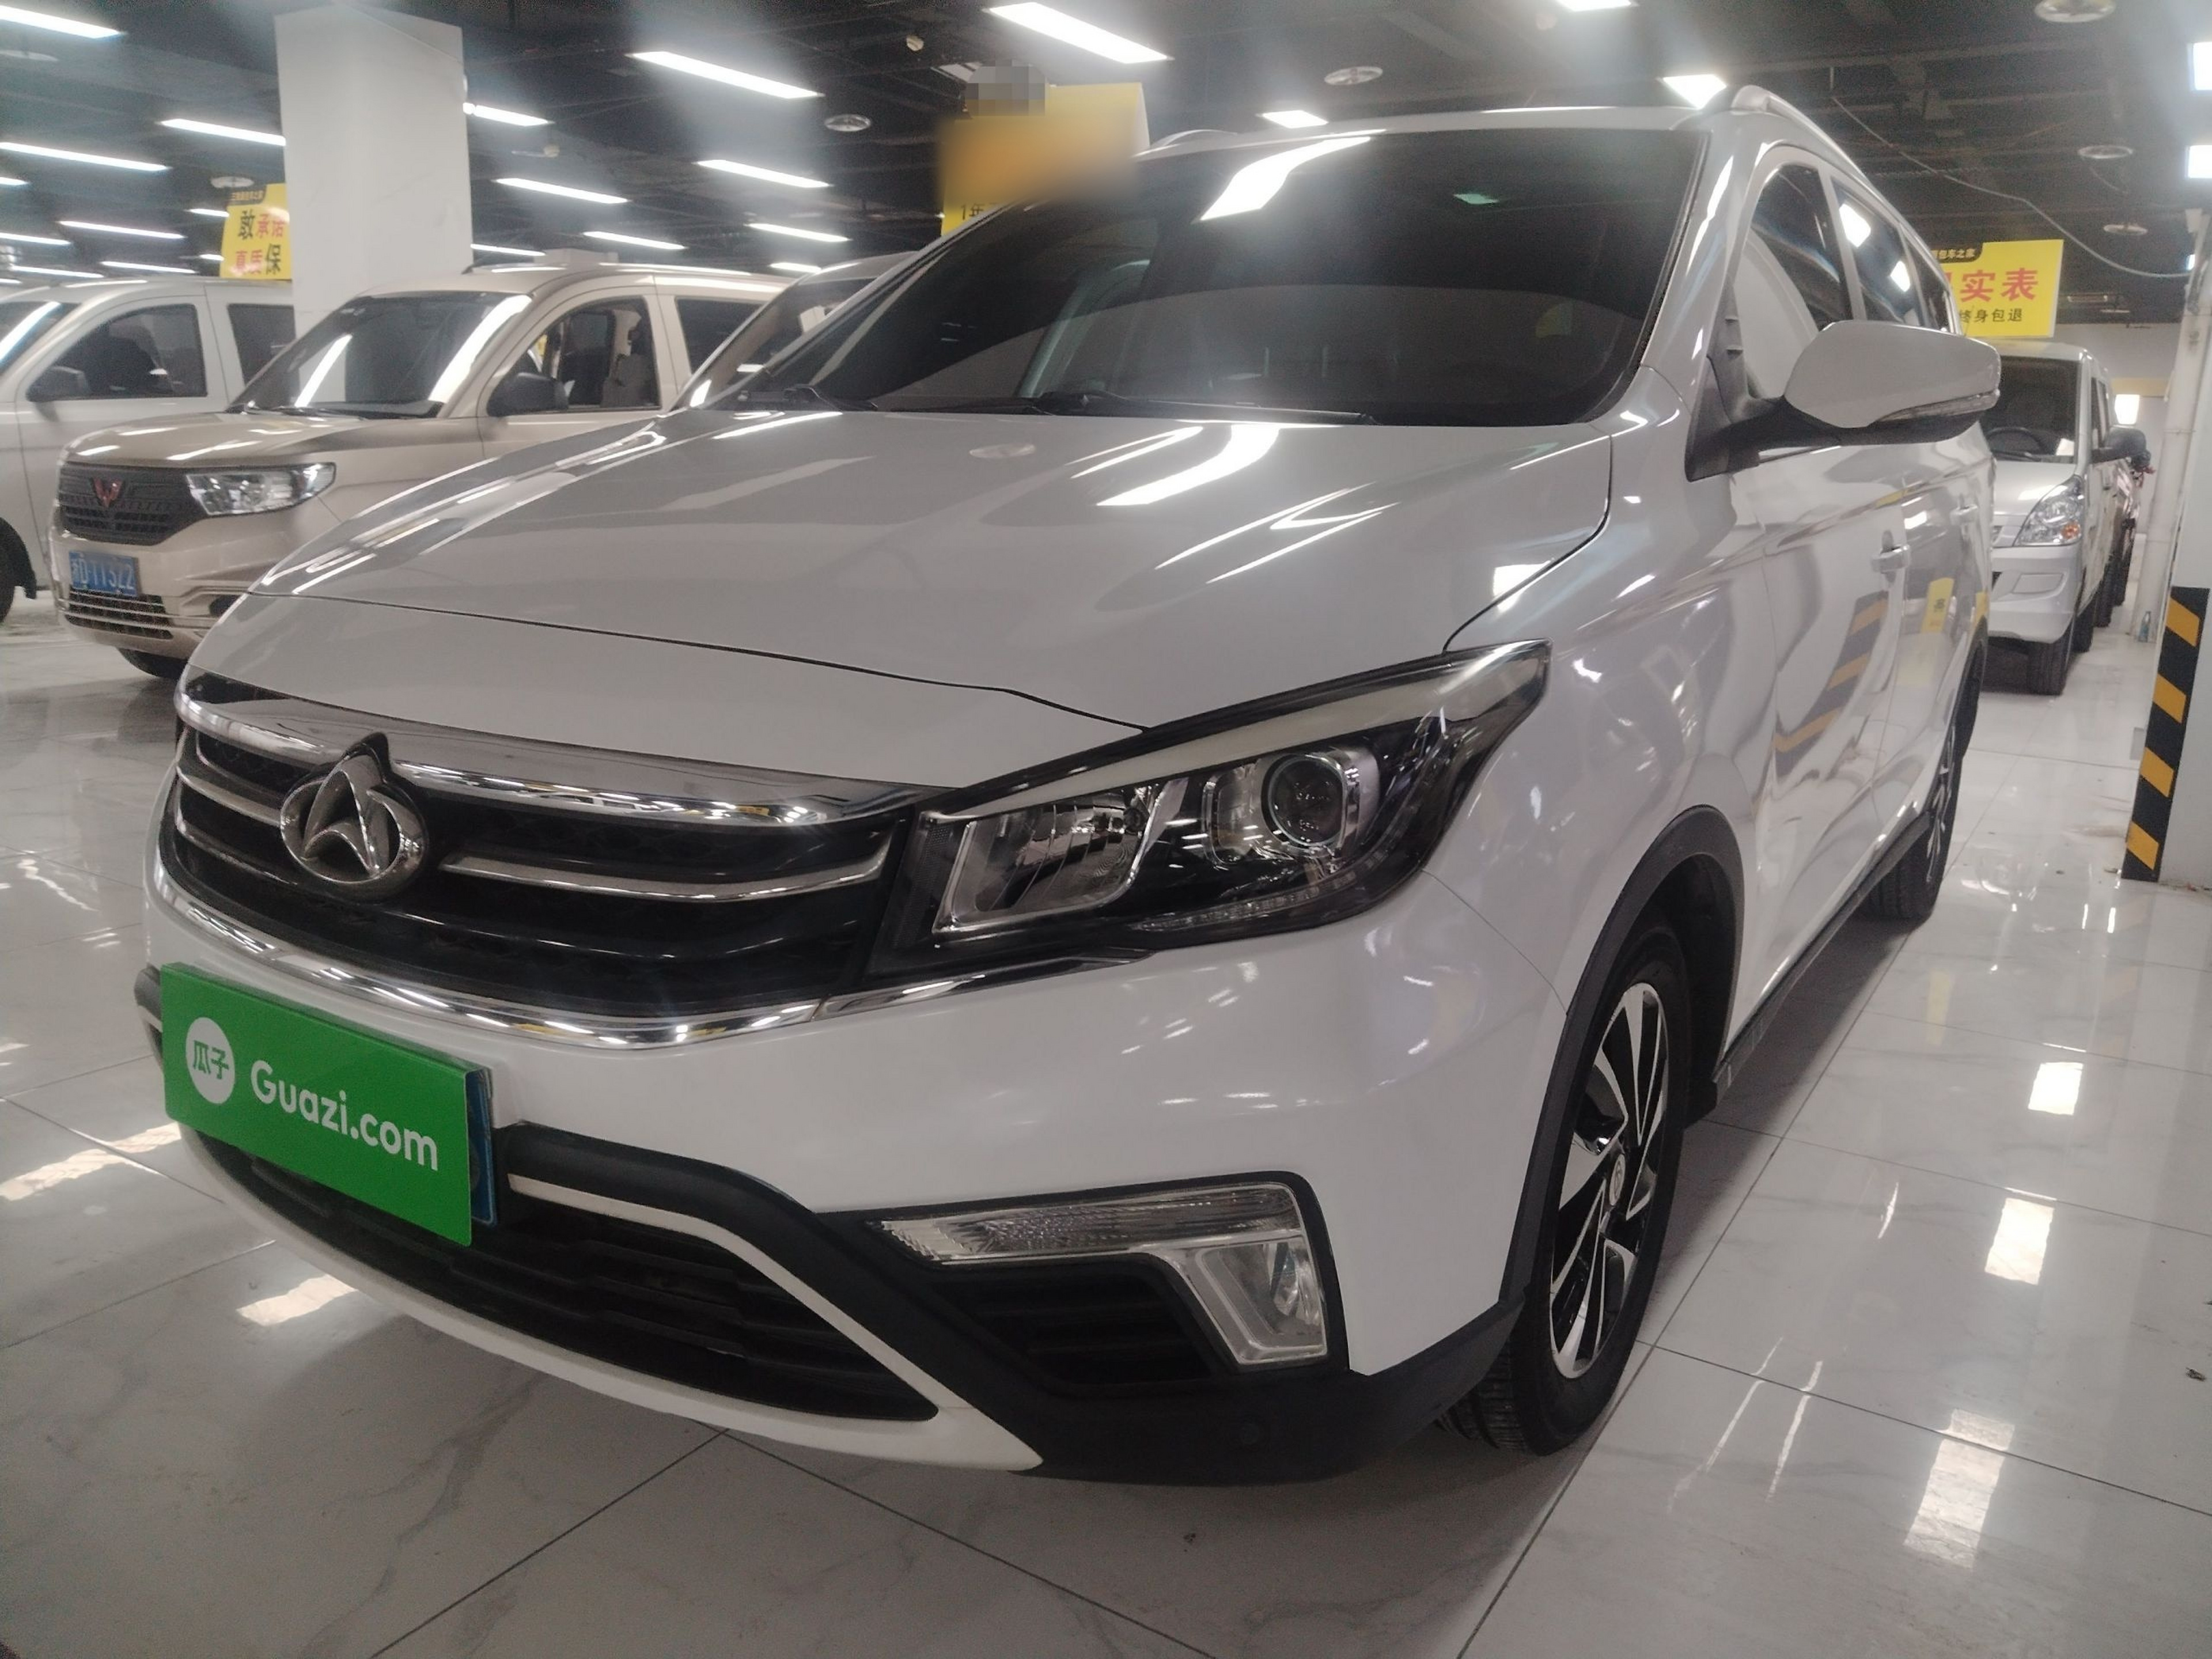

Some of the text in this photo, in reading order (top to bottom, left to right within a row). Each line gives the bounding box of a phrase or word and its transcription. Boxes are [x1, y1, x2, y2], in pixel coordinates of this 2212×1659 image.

[1945, 267, 2038, 302] 实表
[1959, 308, 2022, 323] 终身包退
[192, 1040, 229, 1080] 瓜子
[250, 1059, 438, 1172] Guazi.com
